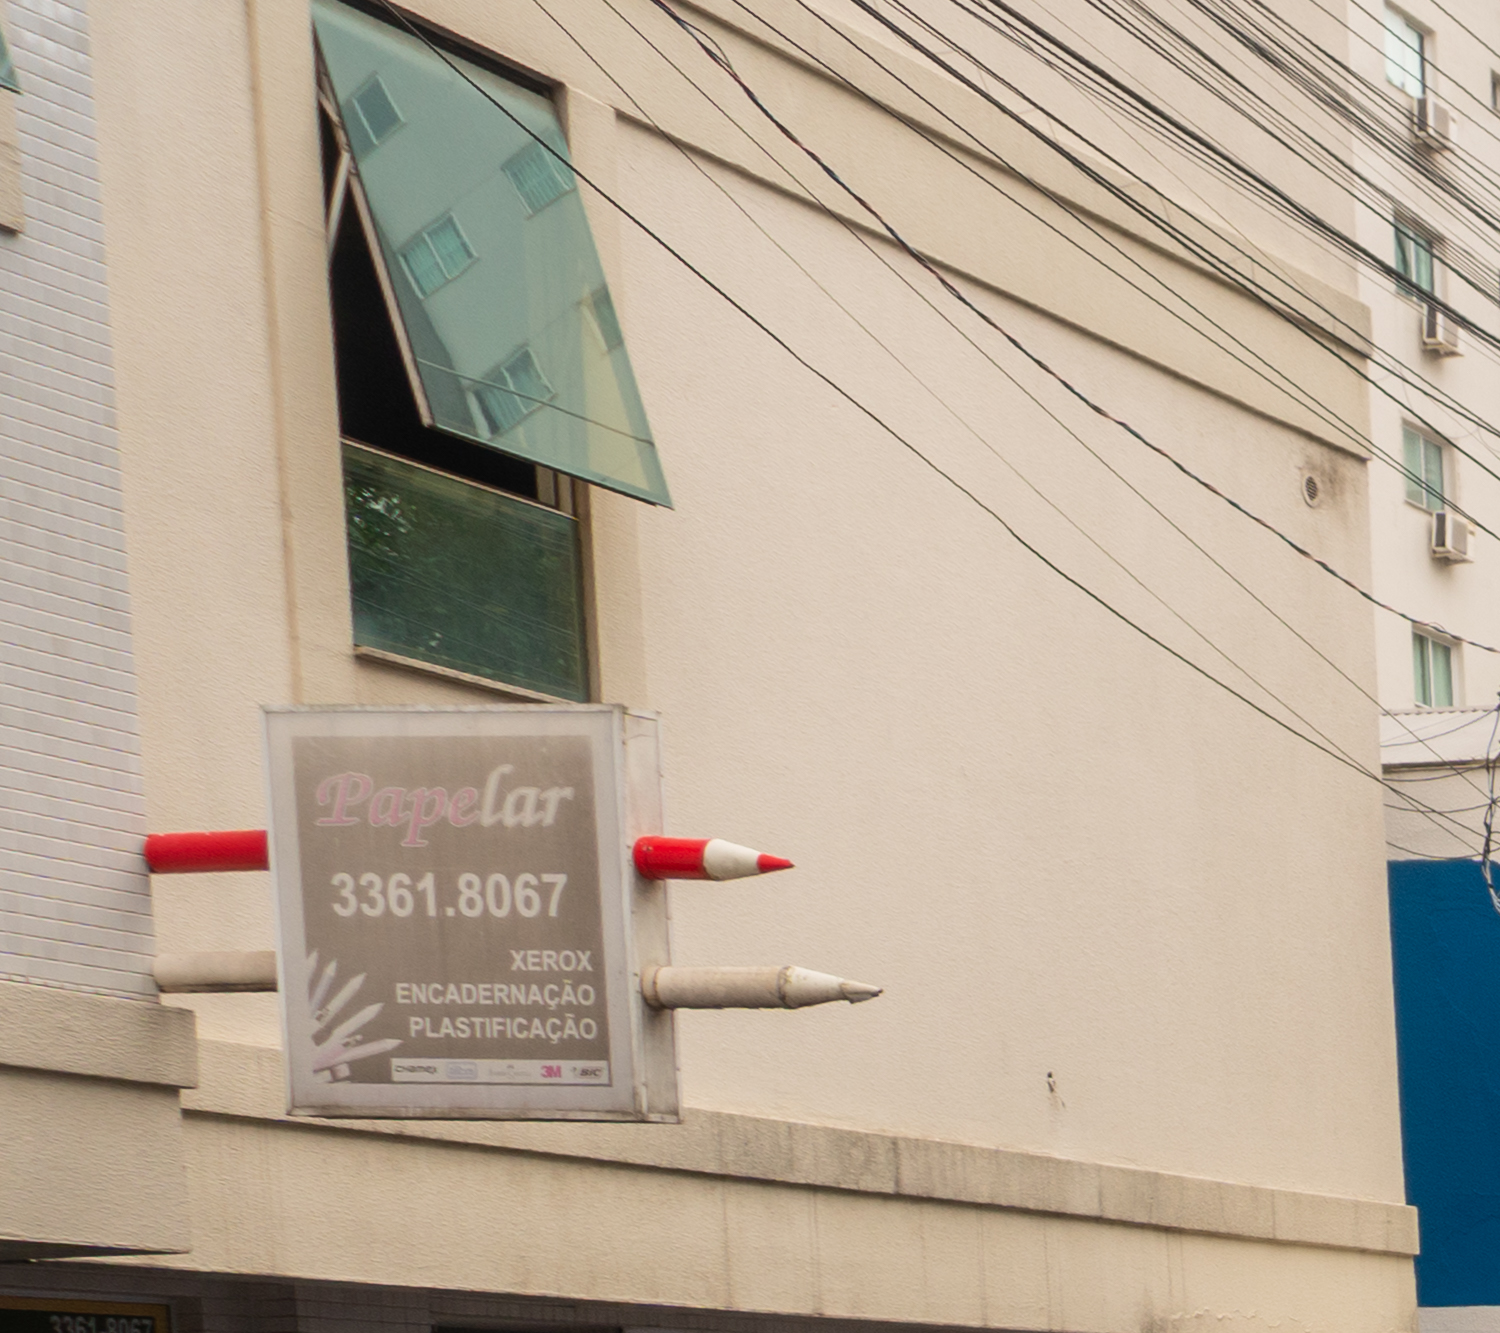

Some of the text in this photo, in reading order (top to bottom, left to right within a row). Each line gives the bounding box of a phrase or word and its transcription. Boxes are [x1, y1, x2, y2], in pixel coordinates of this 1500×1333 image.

[316, 763, 575, 848] Papelar
[330, 872, 568, 918] 3361.8067
[510, 950, 594, 971] XEROX
[395, 979, 596, 1010] ENCADERNAÇÃO
[409, 1013, 598, 1044] PLASTIFICAÇÃO
[541, 1065, 562, 1079] 3M
